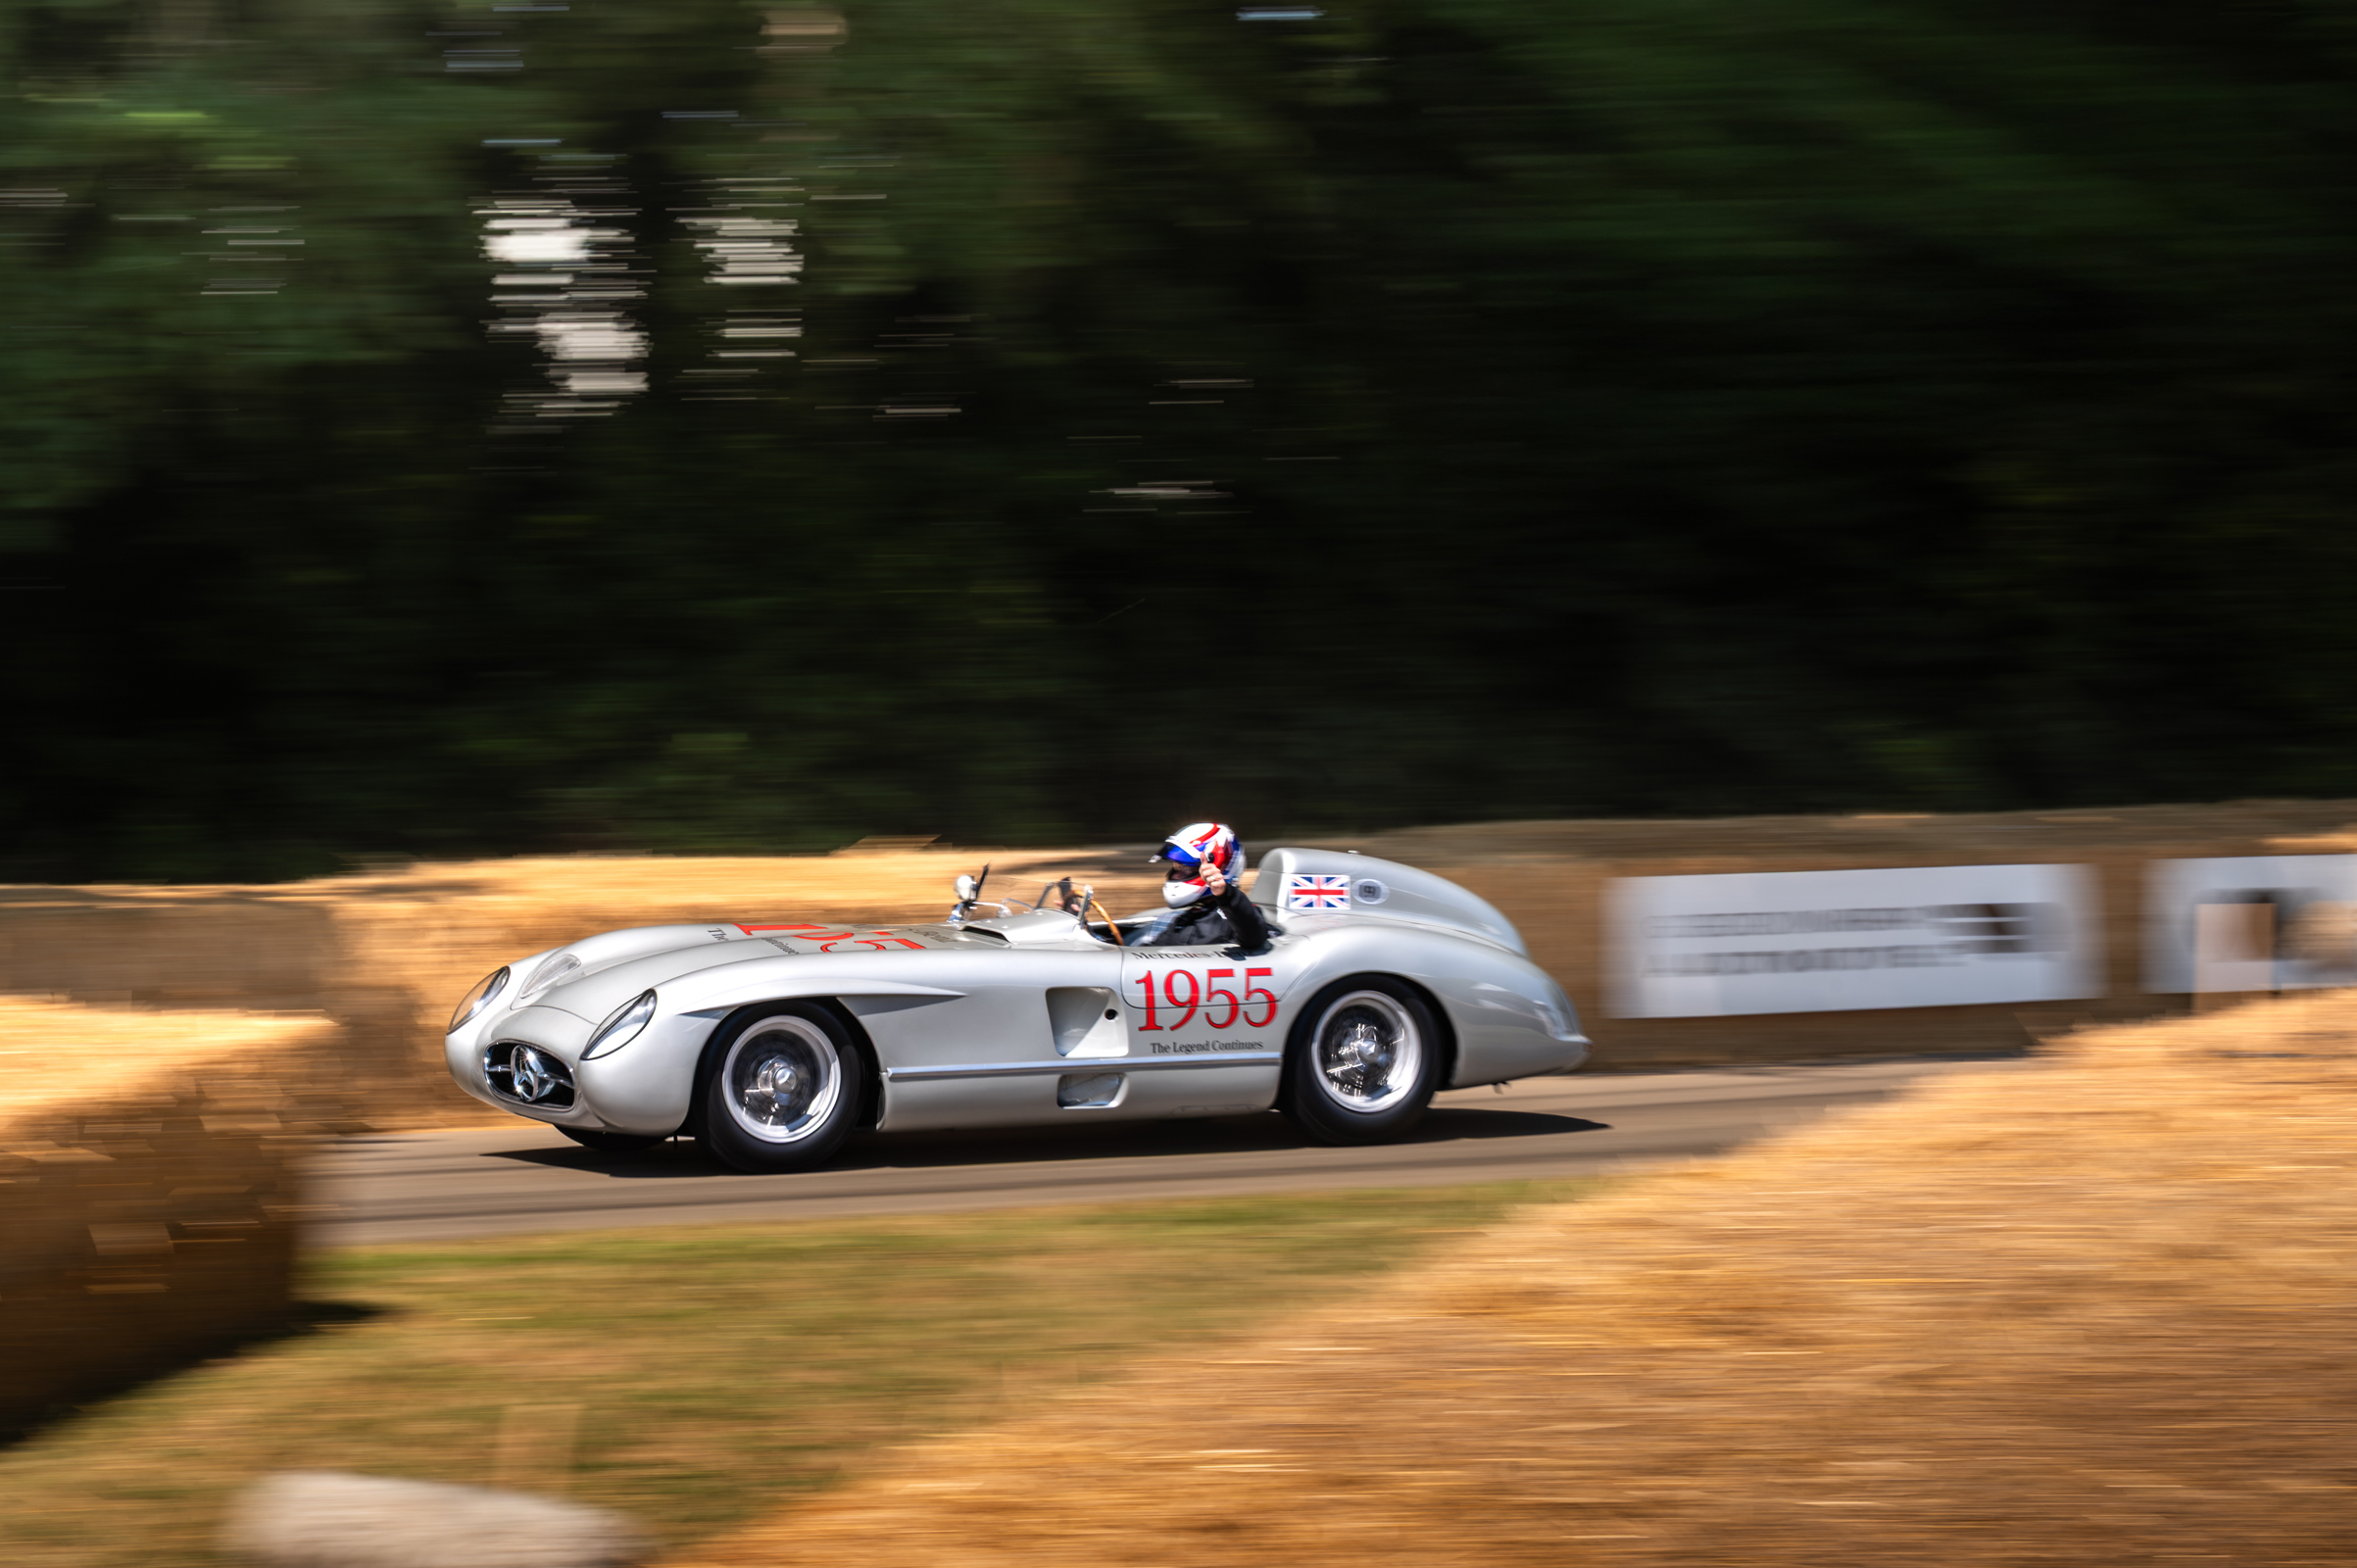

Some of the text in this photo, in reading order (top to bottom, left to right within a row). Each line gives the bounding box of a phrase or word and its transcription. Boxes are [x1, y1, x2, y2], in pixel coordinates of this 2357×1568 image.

[1131, 951, 1248, 959] Mercedes-Ben
[1136, 967, 1278, 1032] 1955
[1150, 1040, 1264, 1054] The Legend Continues
